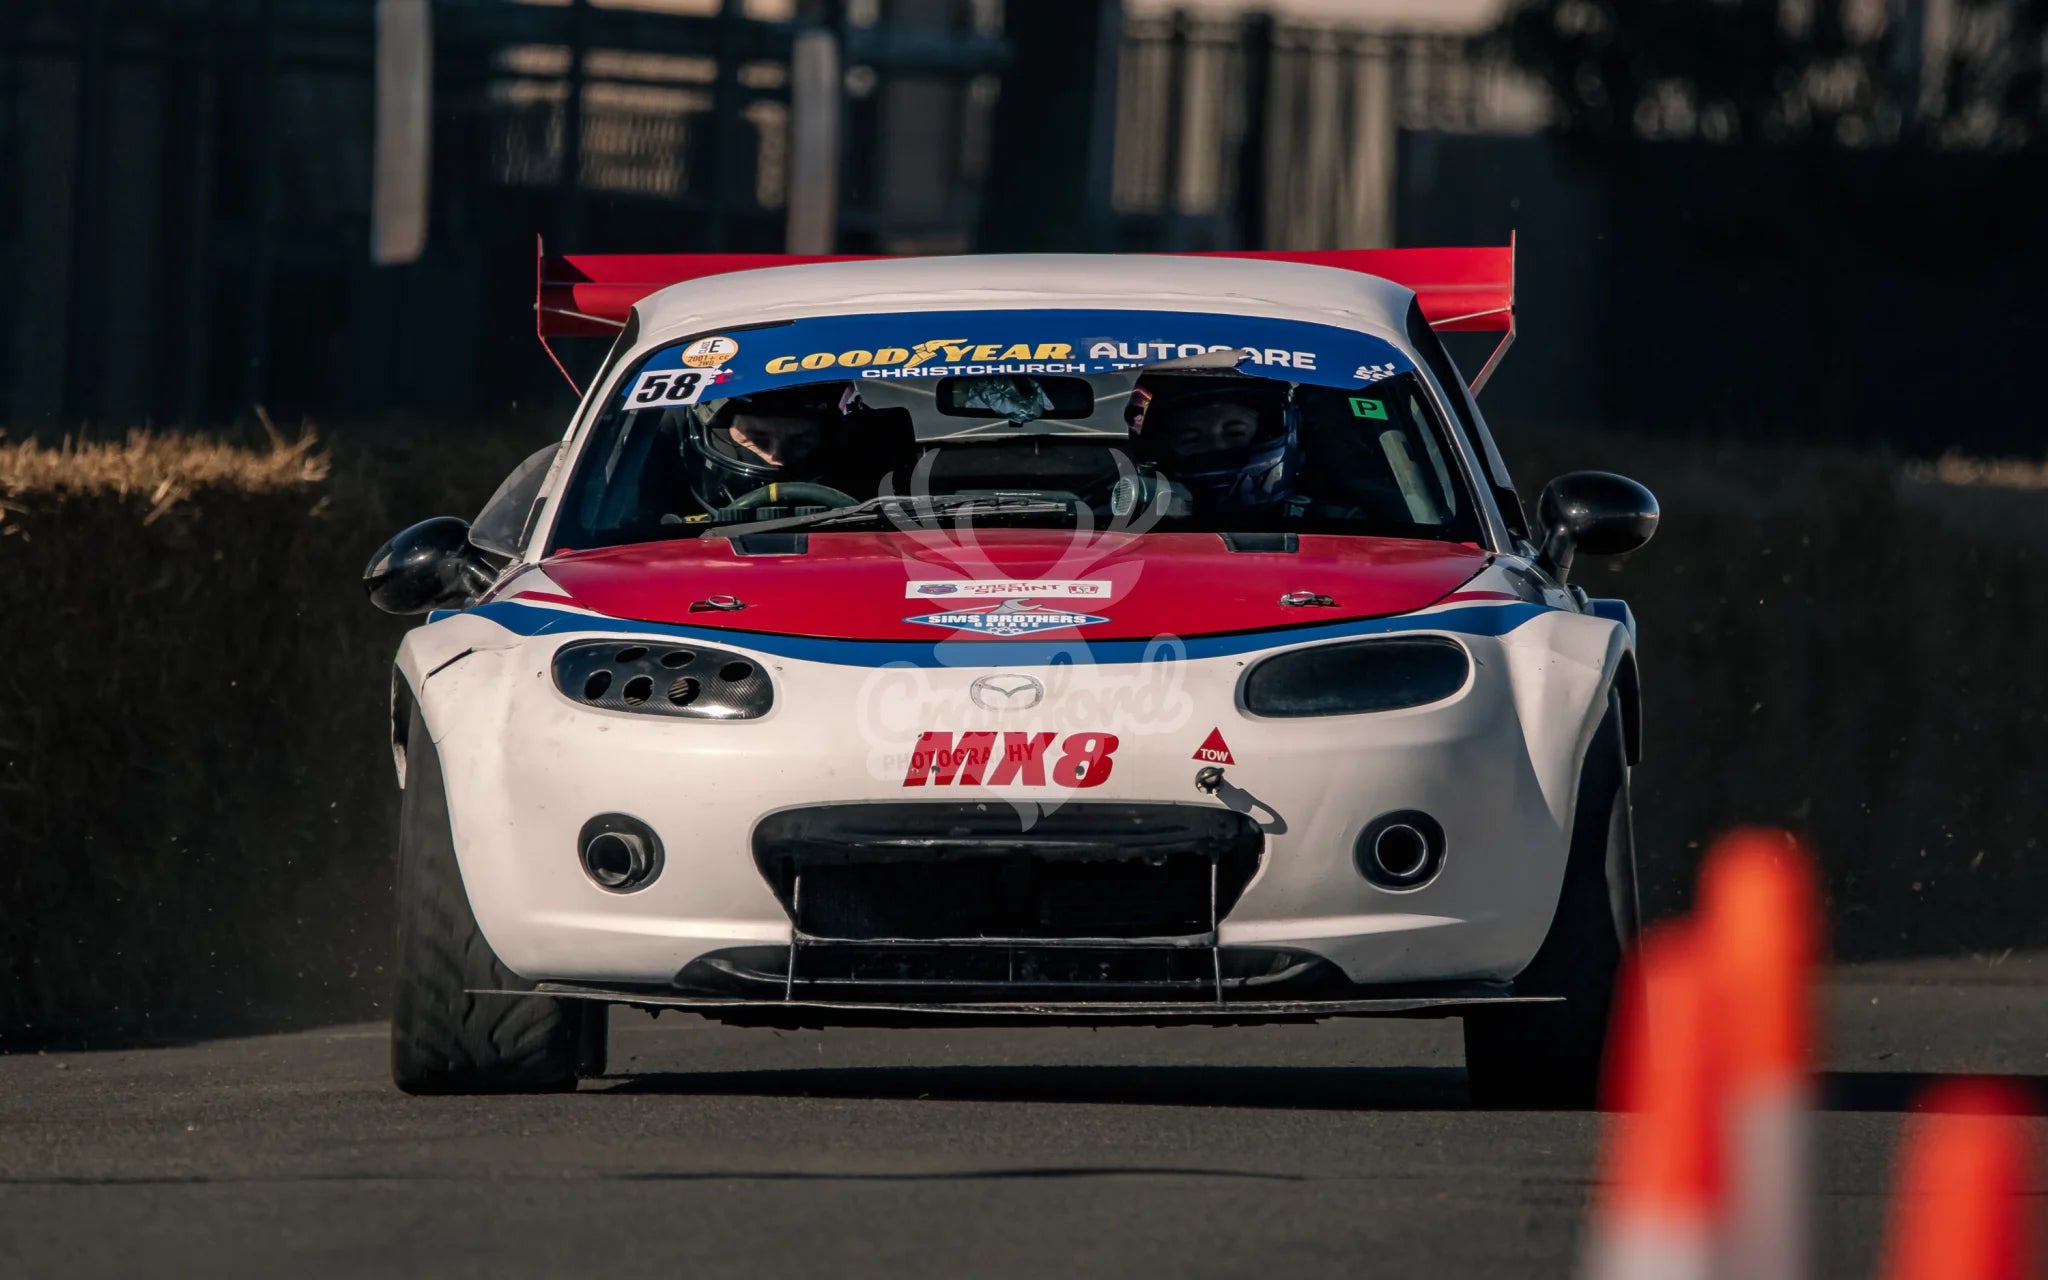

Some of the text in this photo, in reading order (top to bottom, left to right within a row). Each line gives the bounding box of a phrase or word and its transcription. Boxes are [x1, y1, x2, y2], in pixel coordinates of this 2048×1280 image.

[708, 339, 724, 354] E
[765, 342, 1073, 374] GOODYEAR
[861, 362, 1086, 378] CHRISTCHURCH
[636, 373, 701, 403] 58
[1357, 401, 1377, 416] P
[973, 583, 1061, 595] SPRINT
[928, 615, 1087, 624] SIMS BROTHERS
[902, 731, 1120, 788] MX8
[1200, 747, 1229, 763] TOW
